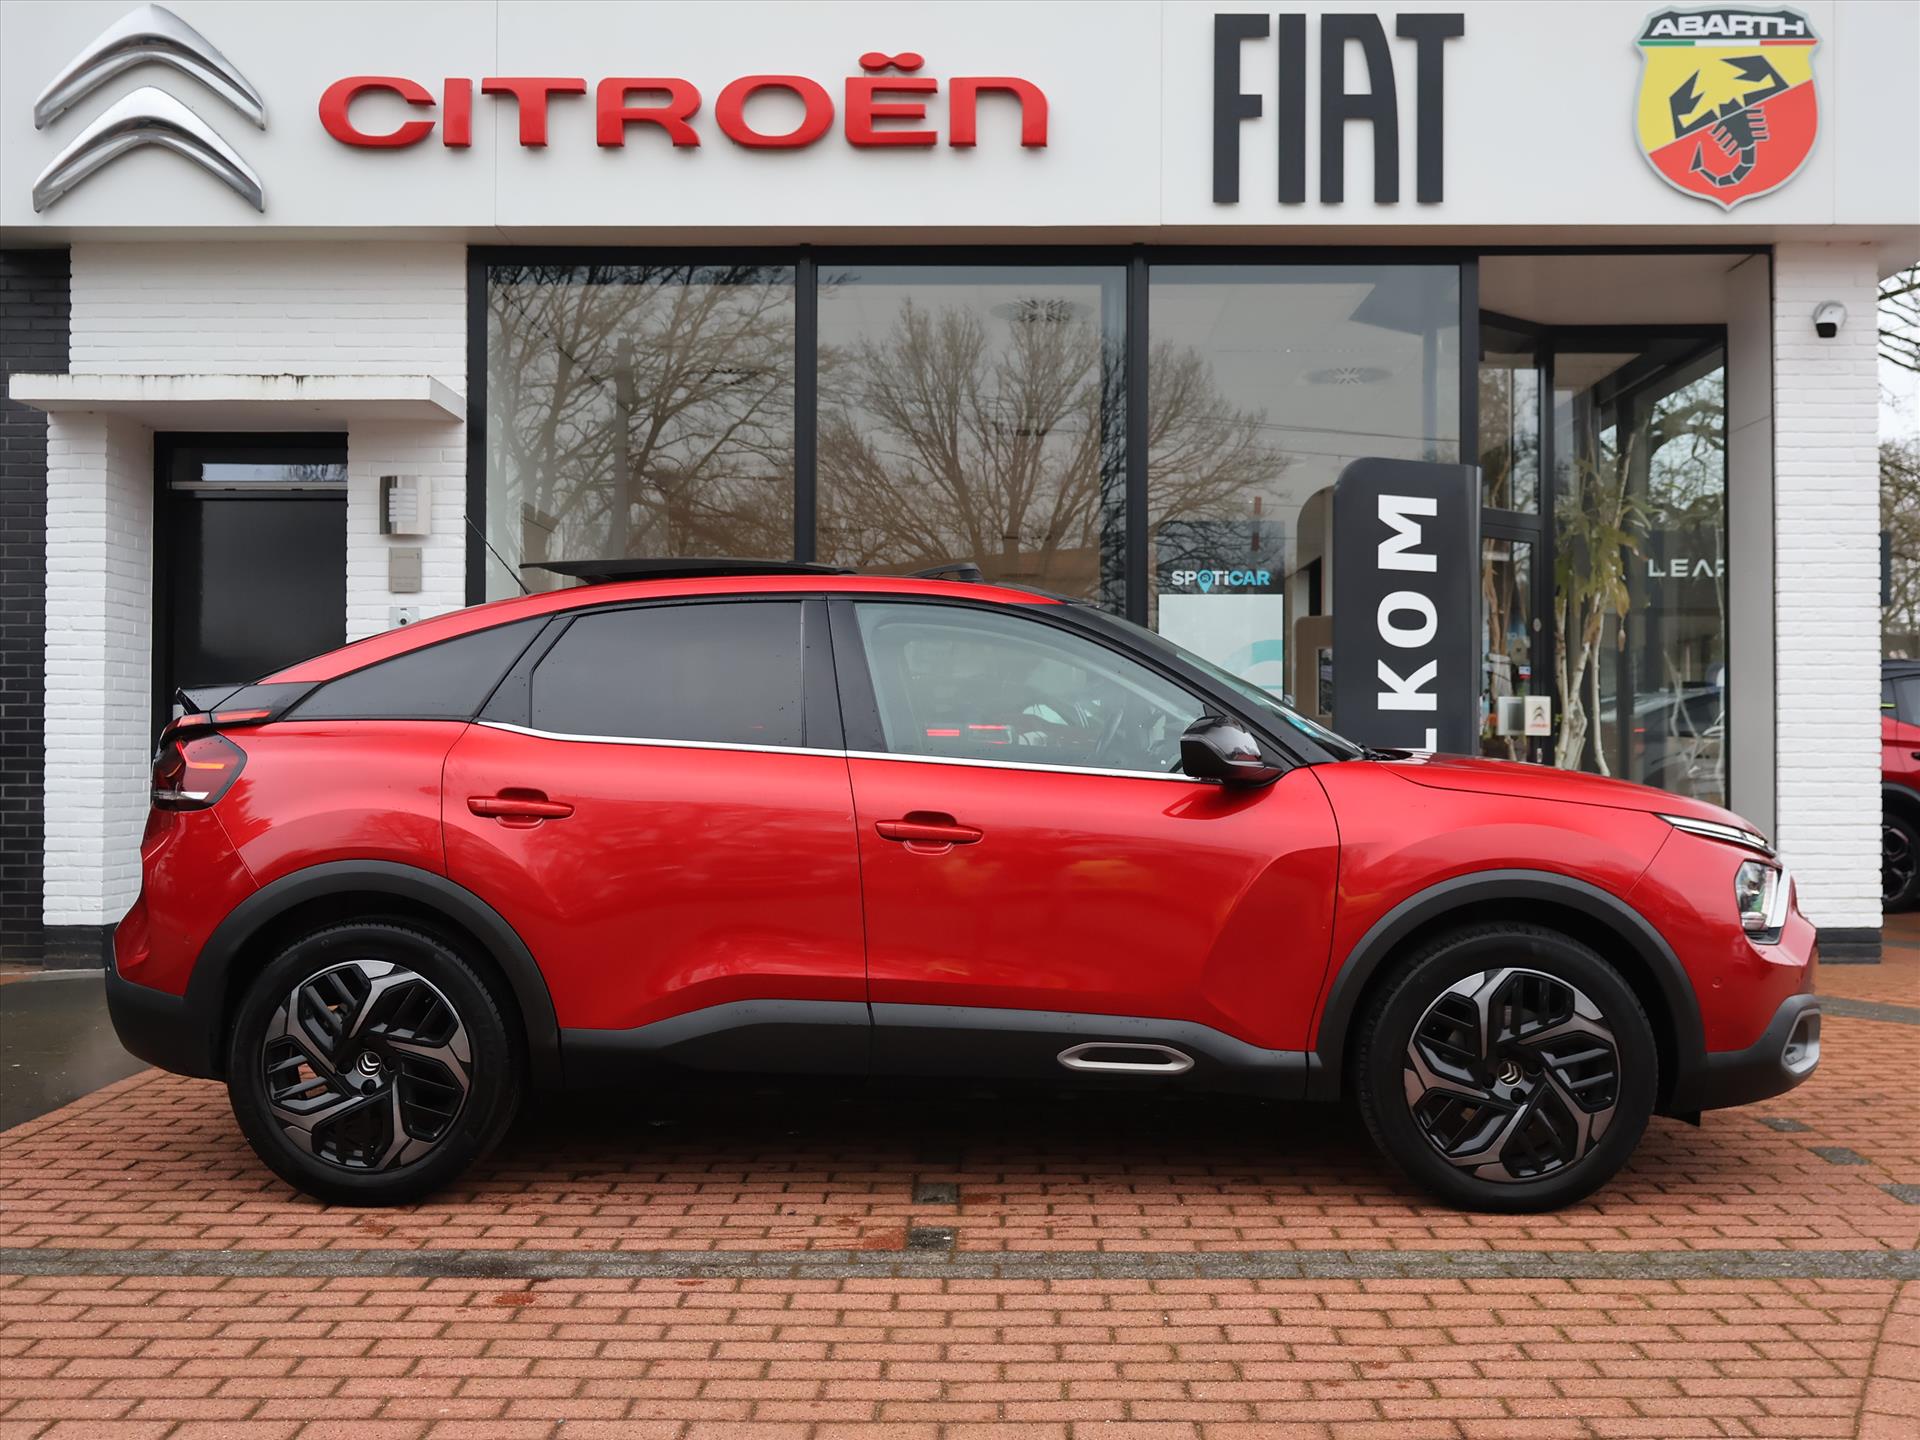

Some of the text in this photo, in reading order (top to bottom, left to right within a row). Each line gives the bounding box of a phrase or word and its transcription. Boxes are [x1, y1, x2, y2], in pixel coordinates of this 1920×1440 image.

[1650, 14, 1805, 37] ABARTH
[319, 52, 1049, 149] CITROËN
[1213, 13, 1464, 206] FIAT
